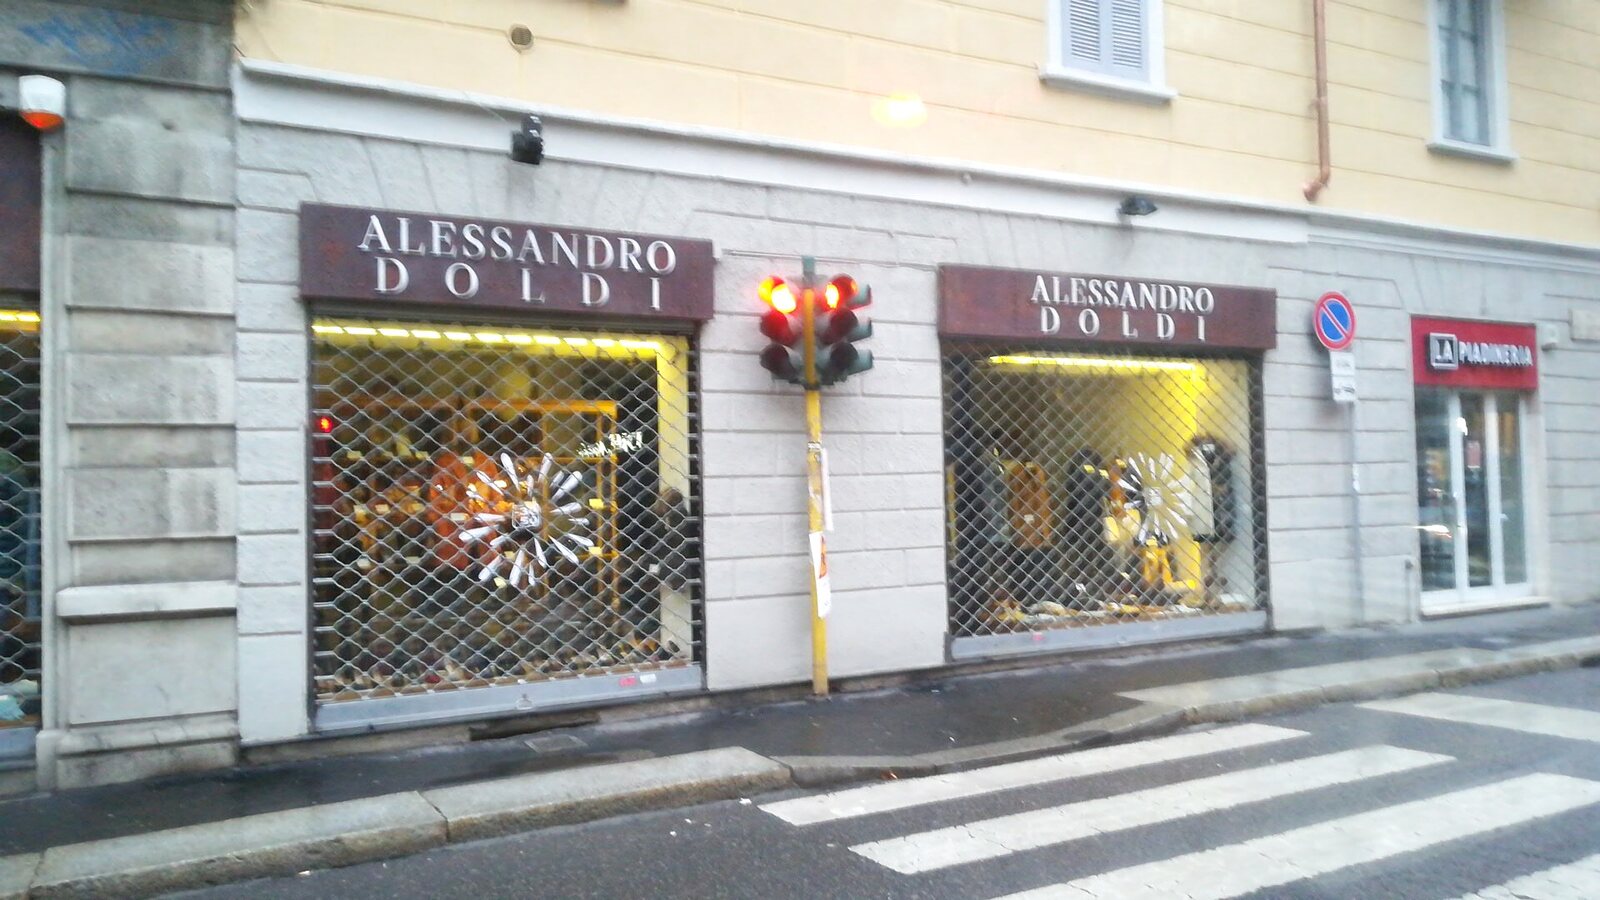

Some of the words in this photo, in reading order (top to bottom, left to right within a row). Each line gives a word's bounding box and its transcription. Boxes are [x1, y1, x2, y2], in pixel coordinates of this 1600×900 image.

[357, 214, 677, 275] ALESSANDRO
[374, 256, 661, 311] DOLDI
[1030, 275, 1215, 315] ALESSANDRO
[1040, 305, 1206, 342] DOLDI
[1431, 336, 1455, 364] LA
